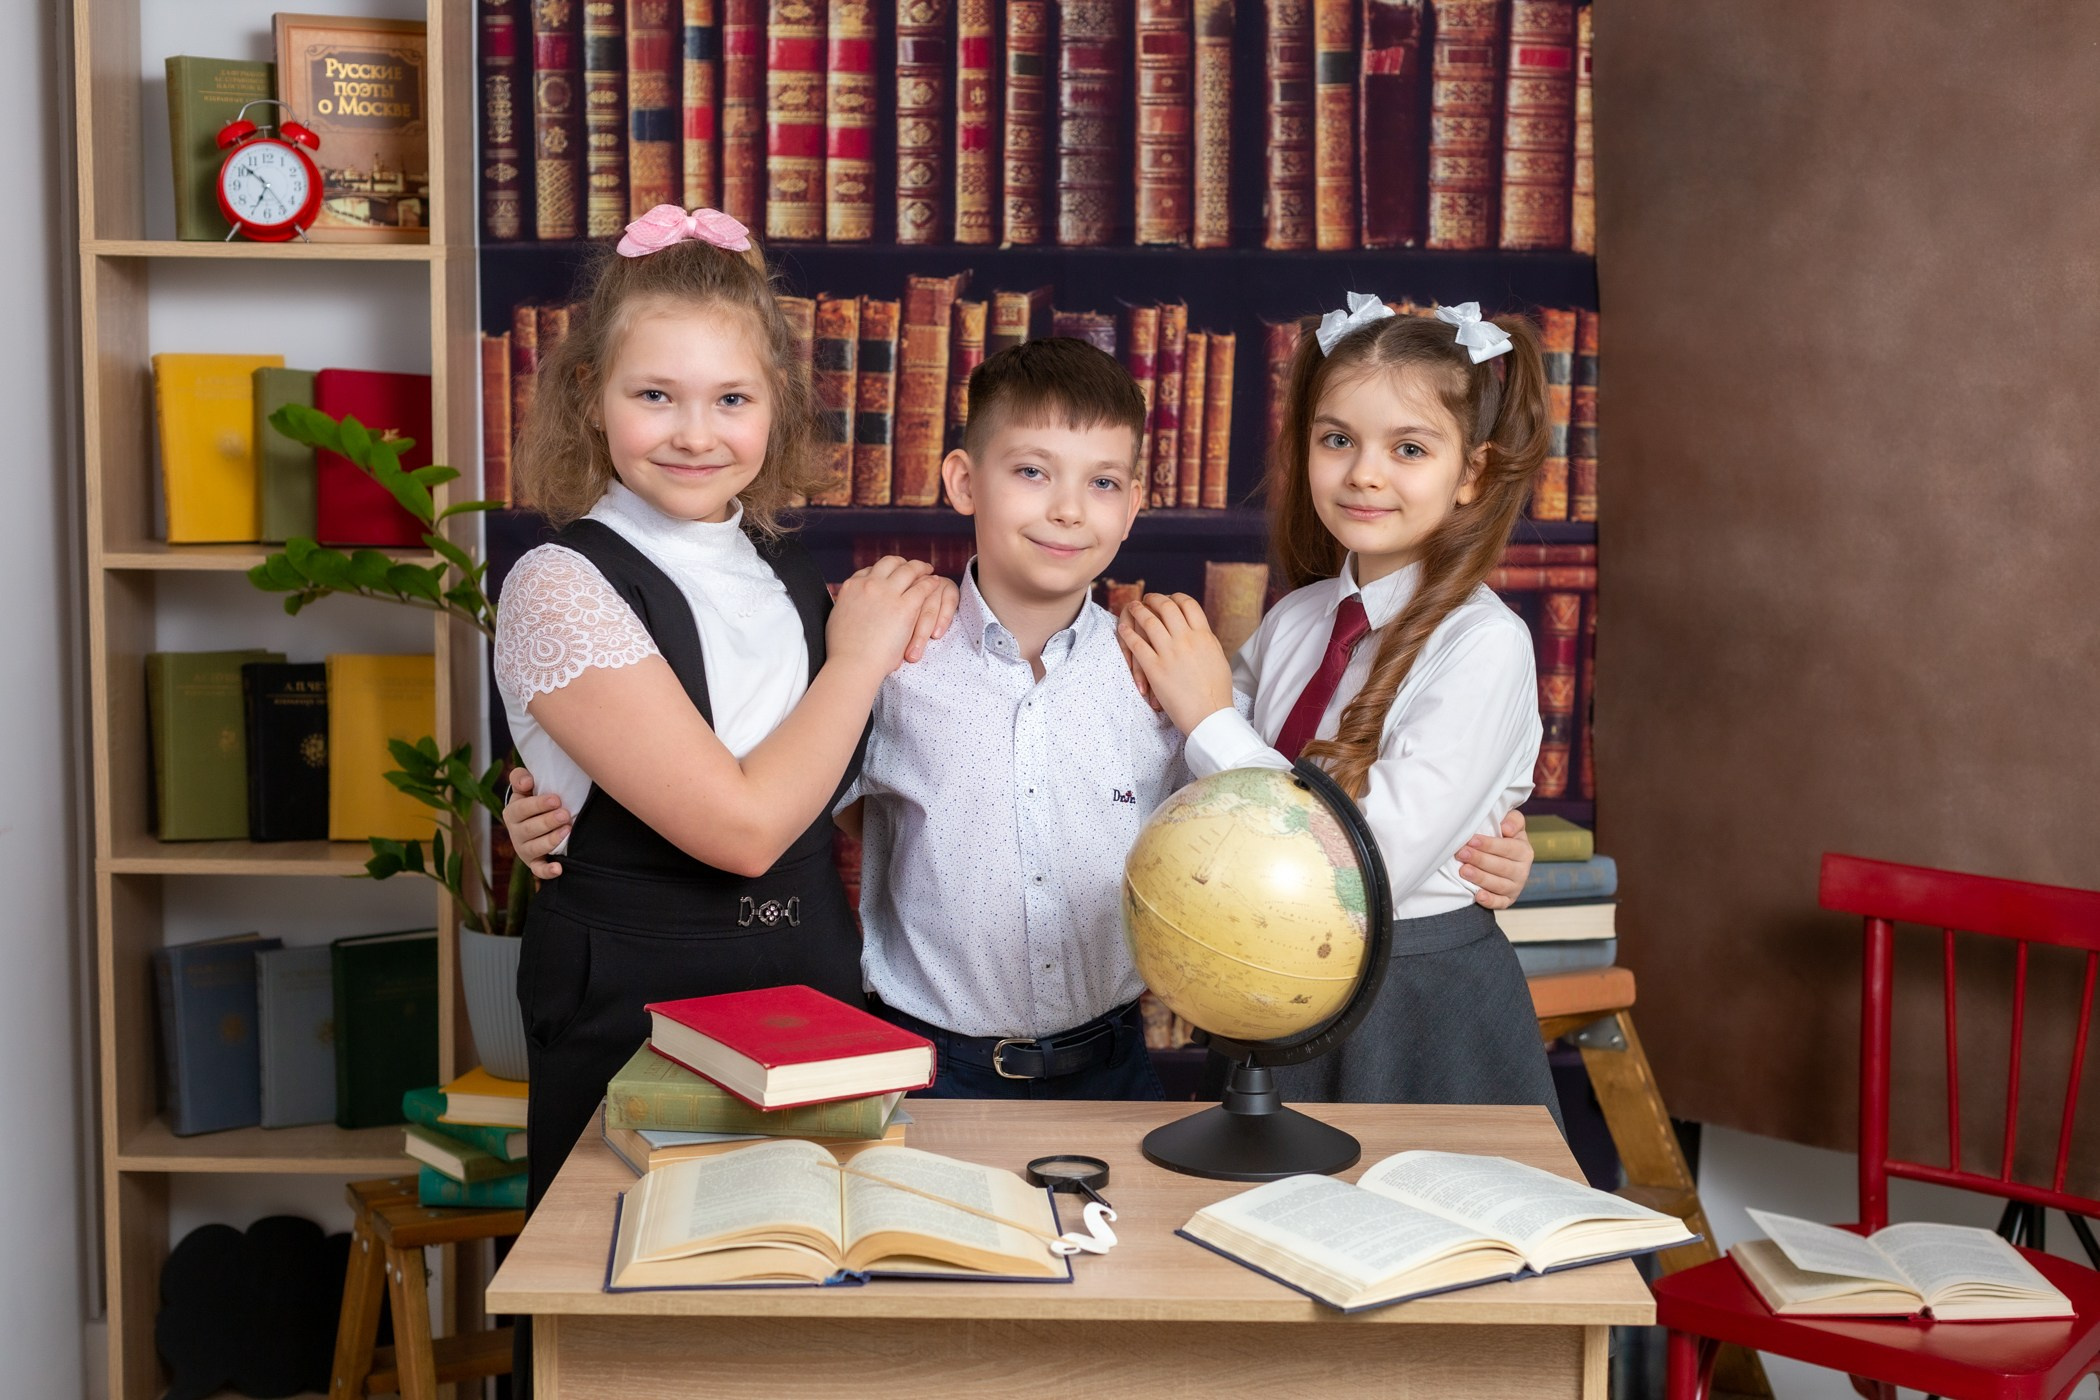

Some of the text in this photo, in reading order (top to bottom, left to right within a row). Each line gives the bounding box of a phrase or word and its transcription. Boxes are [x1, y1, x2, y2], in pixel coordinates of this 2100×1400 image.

[248, 156, 257, 167] 11
[262, 153, 274, 164] 12
[237, 166, 249, 177] 10
[289, 167, 297, 177] 2
[232, 180, 241, 191] 9
[293, 181, 302, 192] 3
[238, 194, 247, 205] 8
[288, 195, 297, 205] 4
[263, 208, 272, 219] 6
[278, 204, 287, 216] 5
